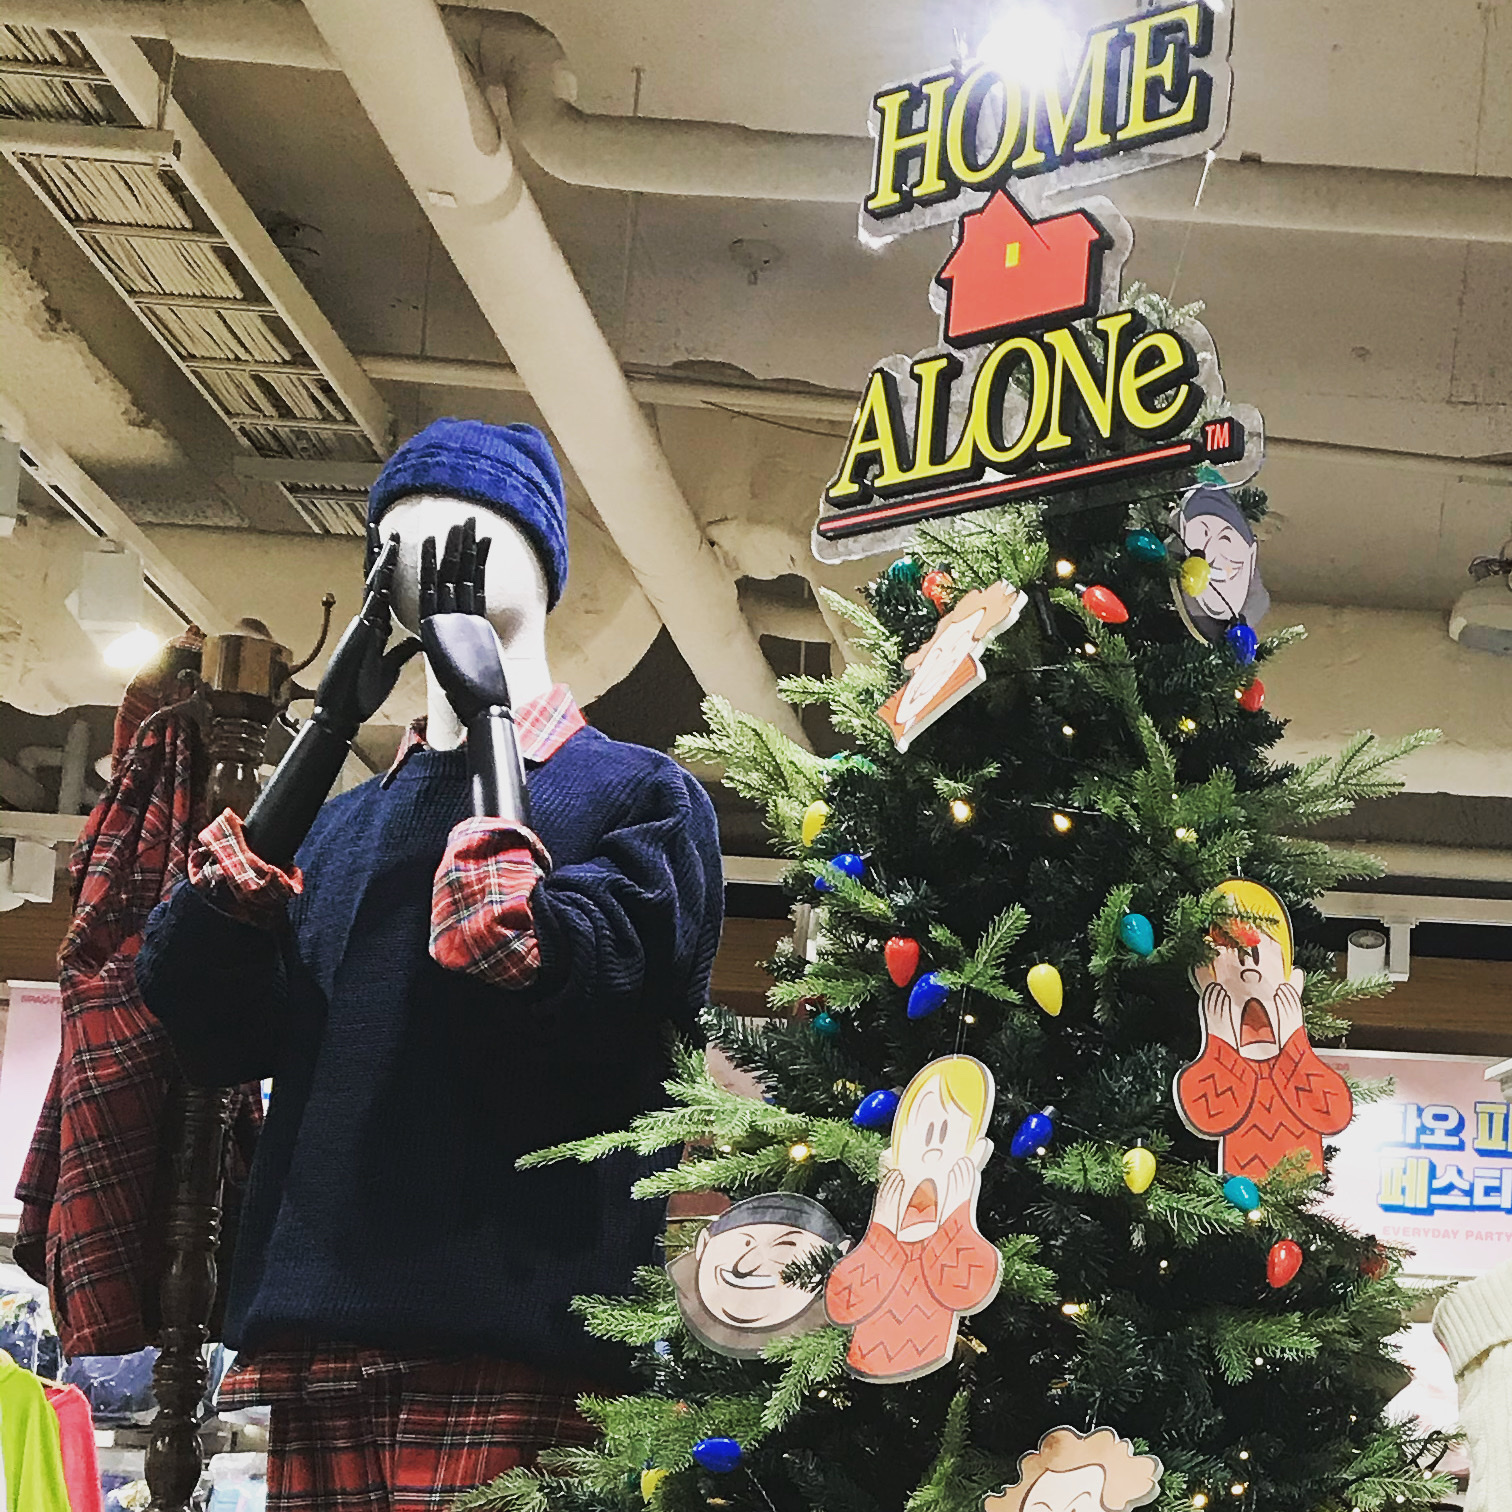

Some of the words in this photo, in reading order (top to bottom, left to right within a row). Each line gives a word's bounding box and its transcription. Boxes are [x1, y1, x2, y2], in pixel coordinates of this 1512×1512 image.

[866, 3, 1203, 212] HOME
[1382, 1225, 1459, 1240] EVERYDAY
[1465, 1229, 1512, 1243] PARTY
